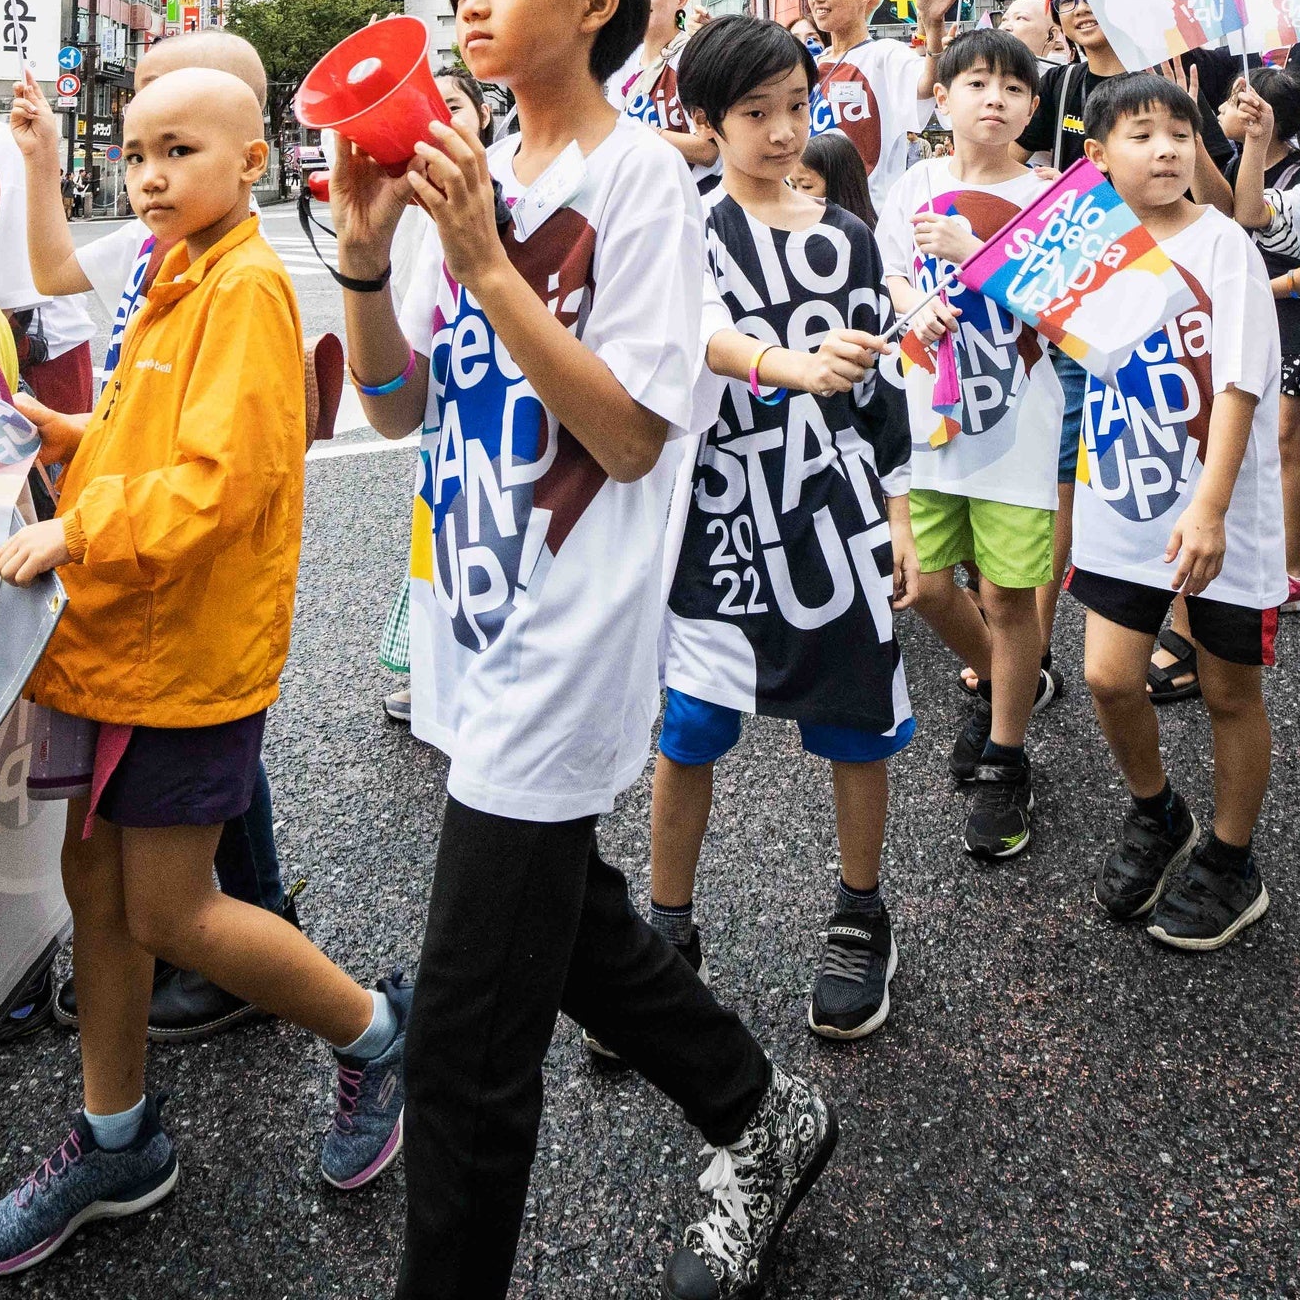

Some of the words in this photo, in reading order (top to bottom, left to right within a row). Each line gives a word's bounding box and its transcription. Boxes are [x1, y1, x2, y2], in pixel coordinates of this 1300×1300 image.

[1037, 188, 1107, 231] Alo
[705, 218, 851, 313] Alo
[1004, 228, 1098, 304] STAND
[1039, 215, 1128, 269] pecia
[1005, 273, 1064, 319] UP!
[1086, 435, 1200, 520] UP!
[706, 514, 753, 566] 20
[712, 570, 769, 616] 22
